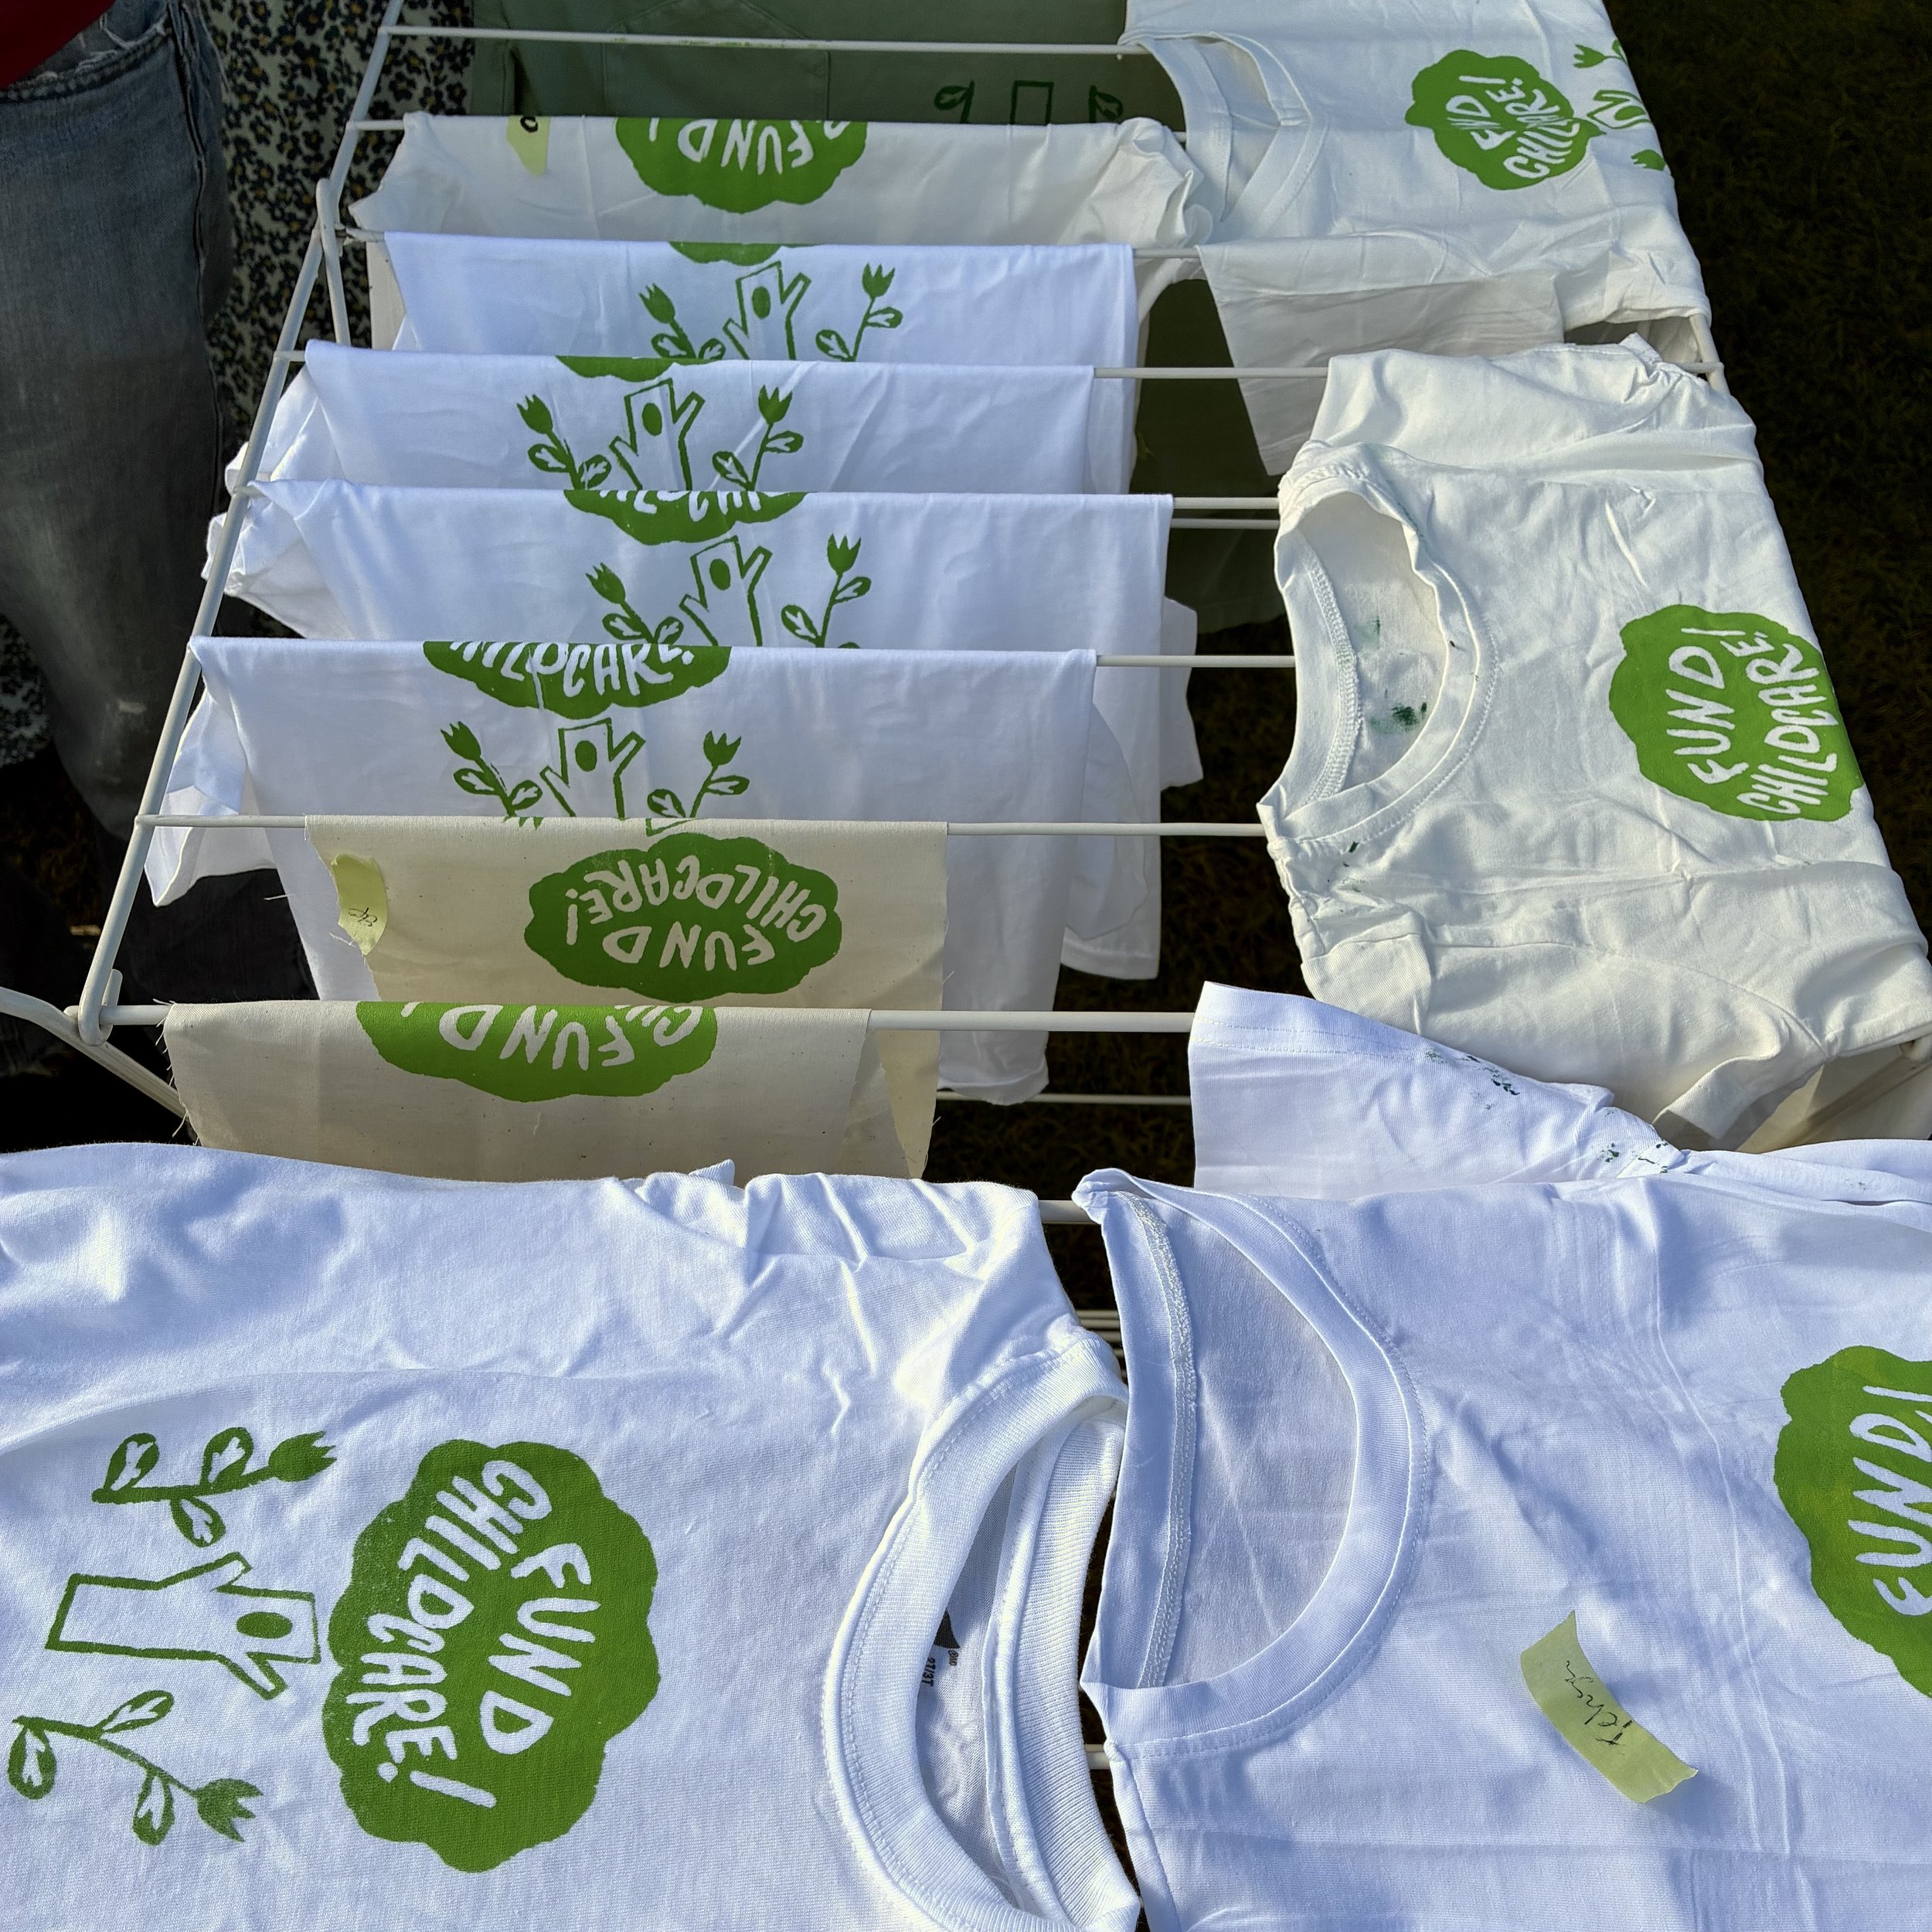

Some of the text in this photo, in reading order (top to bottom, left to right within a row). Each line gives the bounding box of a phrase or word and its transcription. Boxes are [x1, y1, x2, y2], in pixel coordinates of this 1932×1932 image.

[677, 118, 815, 175] FUND
[1665, 645, 1750, 784] FUND
[1680, 627, 1839, 815] CHILDCARE!
[565, 854, 827, 946] CHILDCARE!
[602, 921, 776, 971] FUND
[438, 1004, 635, 1071] FUND
[345, 1460, 553, 1809] CHILDCARE!
[478, 1542, 602, 1755] FUND
